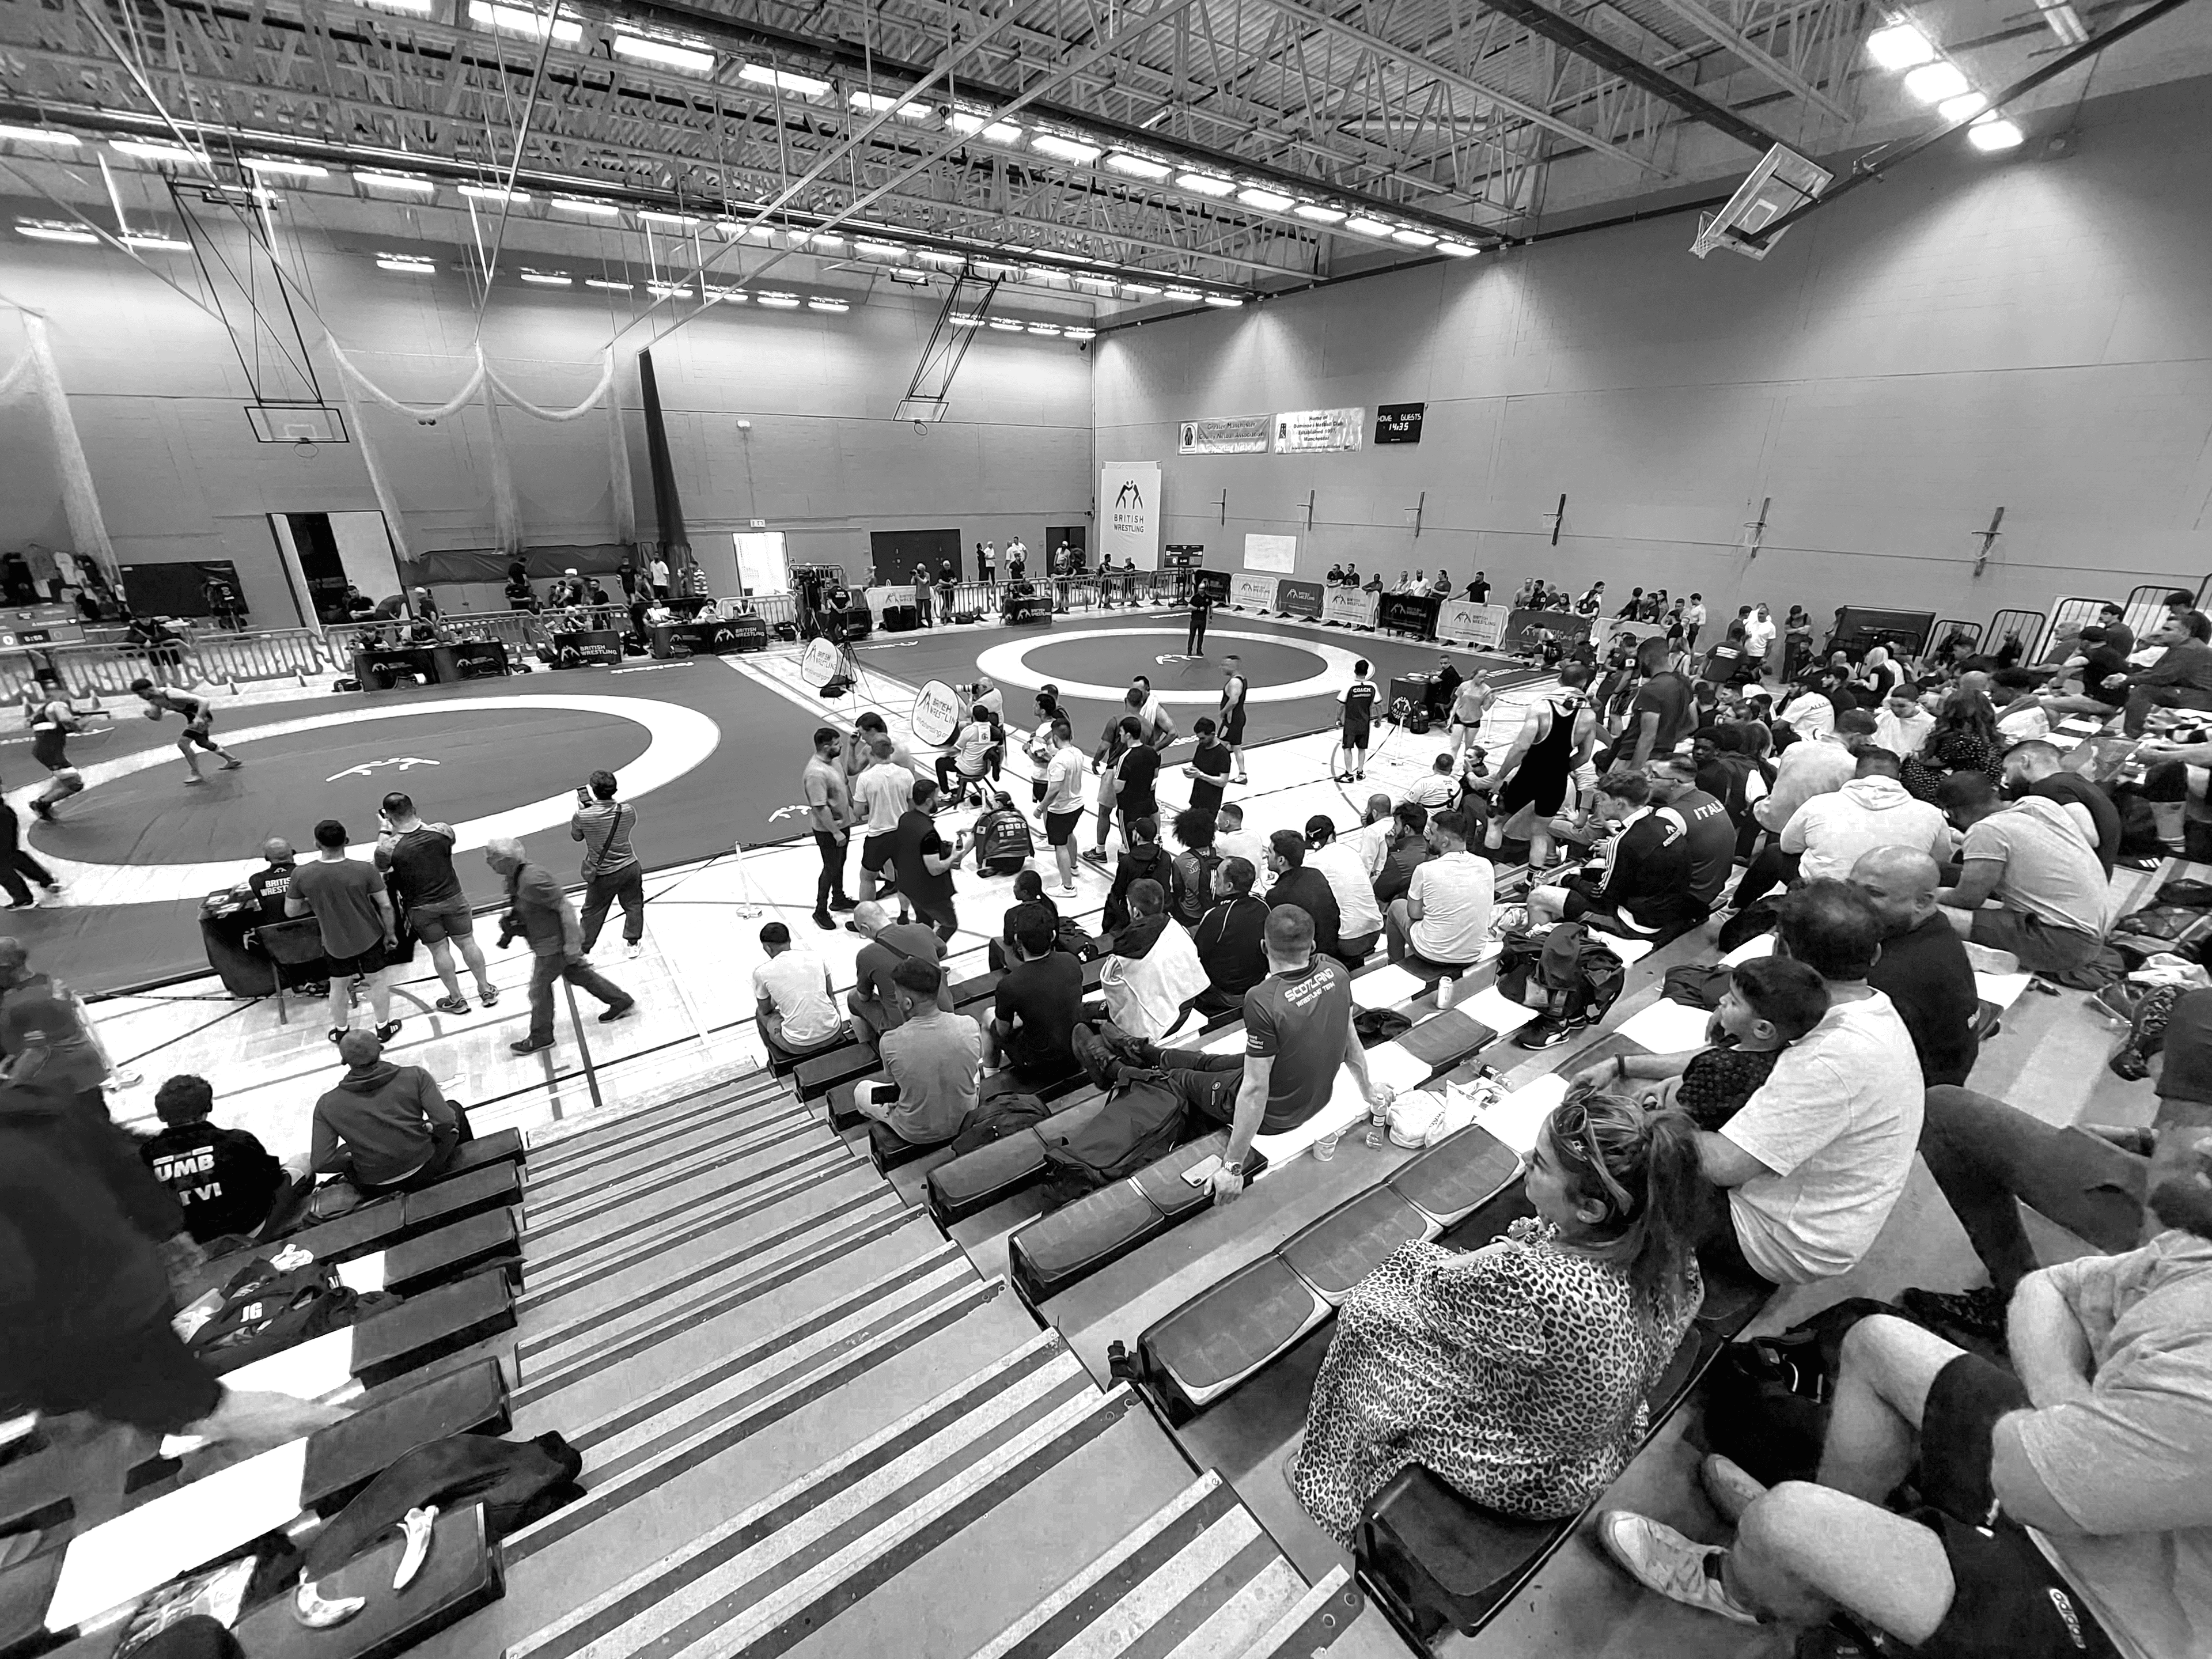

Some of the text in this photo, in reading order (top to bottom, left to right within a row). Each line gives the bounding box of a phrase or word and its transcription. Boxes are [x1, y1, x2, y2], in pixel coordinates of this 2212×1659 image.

[1400, 412, 1421, 421] GUESTS
[1113, 514, 1144, 524] BRITISH
[1113, 524, 1144, 533] WRESTLING
[264, 877, 292, 888] BRITIS
[1284, 968, 1335, 1002] SCOTLAND
[1296, 987, 1323, 1008] WRESTLING
[2049, 1588, 2086, 1649] adidas
